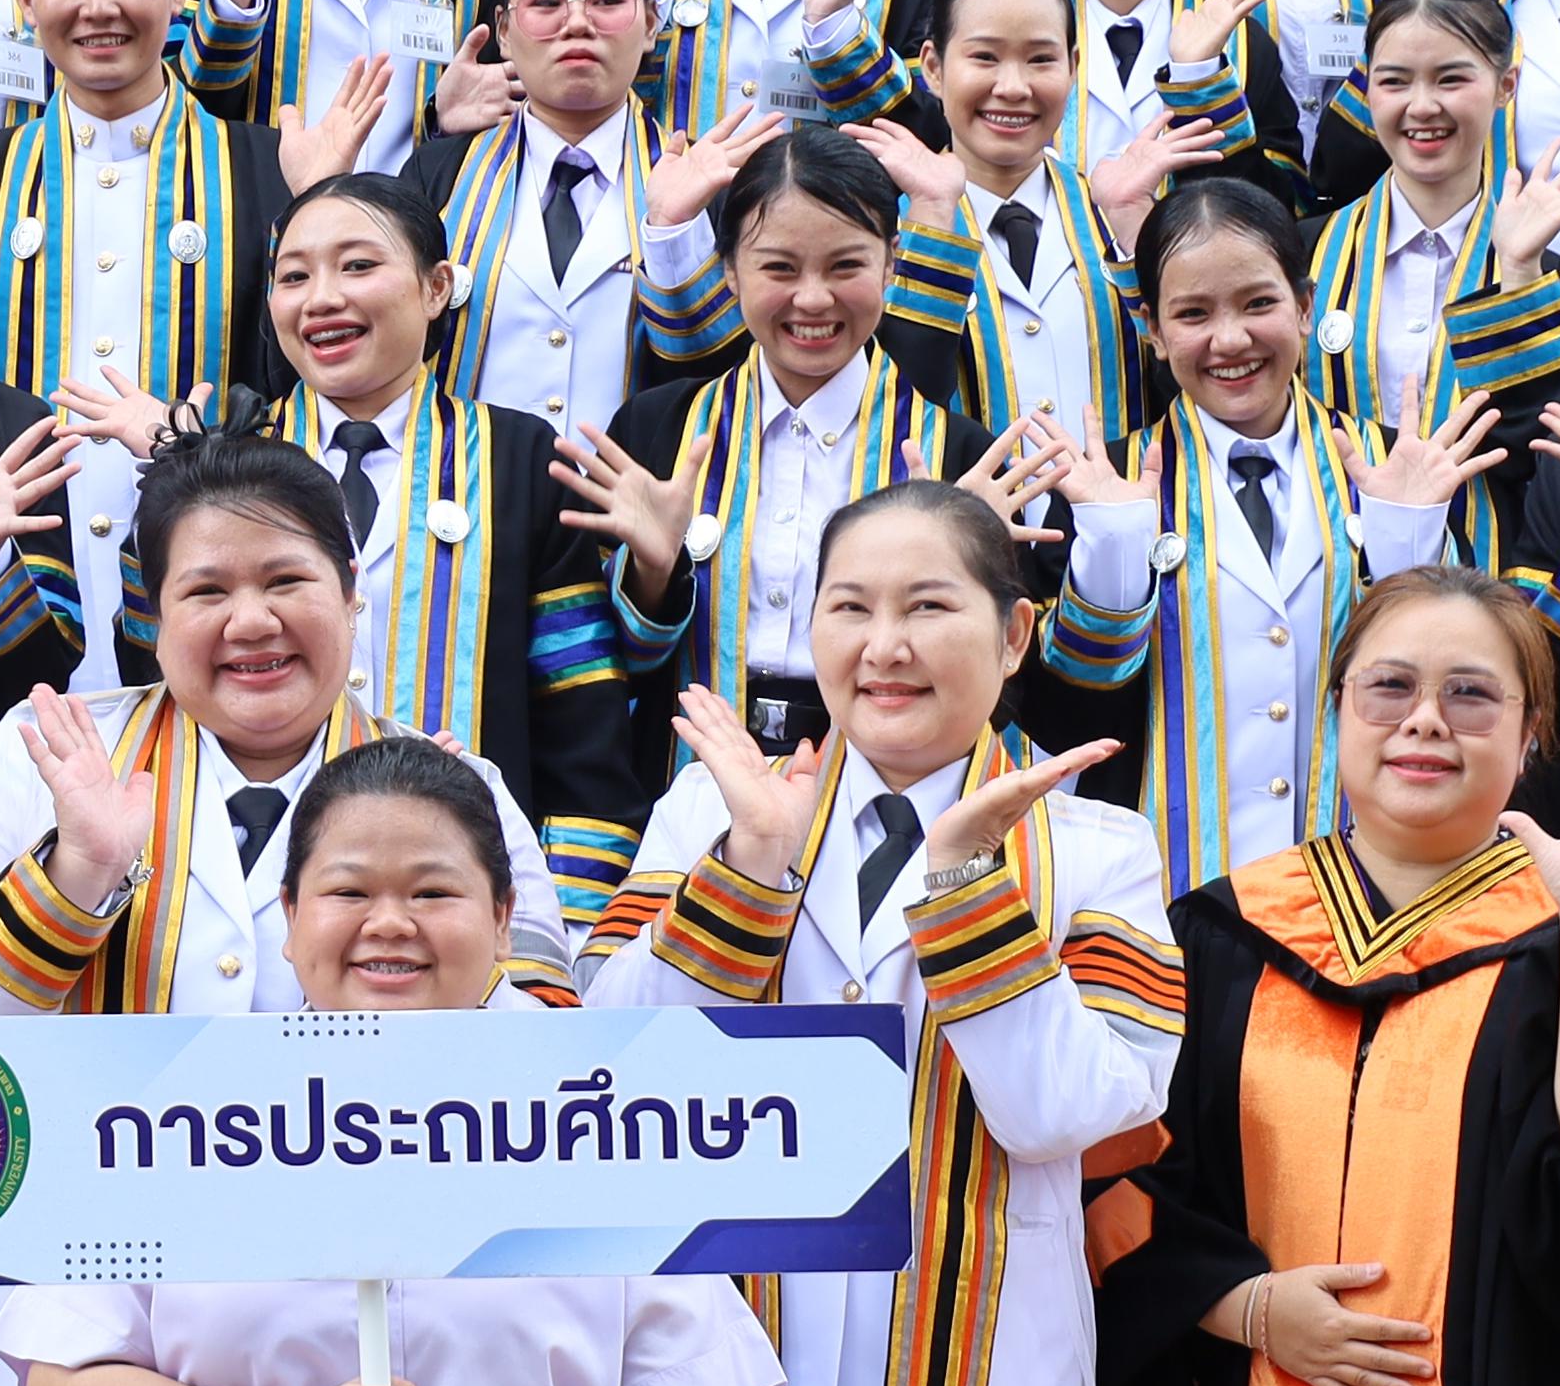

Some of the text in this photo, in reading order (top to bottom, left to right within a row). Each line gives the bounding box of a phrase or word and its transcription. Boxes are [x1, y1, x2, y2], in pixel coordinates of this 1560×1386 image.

[95, 1068, 800, 1170] การประถมศึกษา
